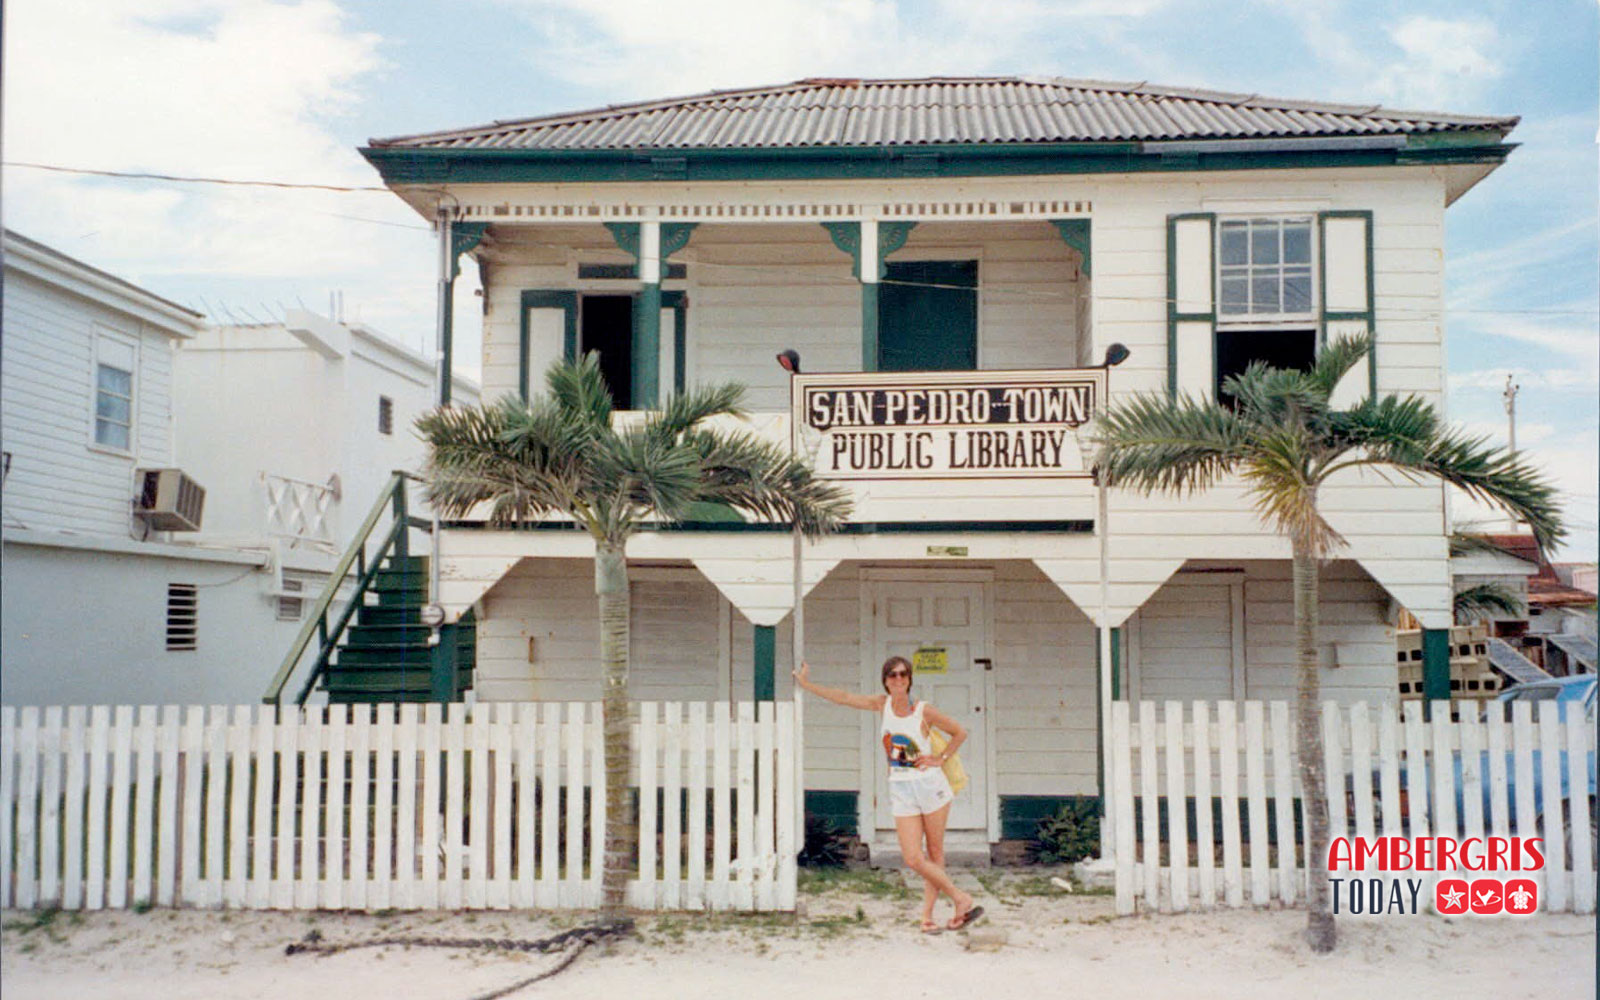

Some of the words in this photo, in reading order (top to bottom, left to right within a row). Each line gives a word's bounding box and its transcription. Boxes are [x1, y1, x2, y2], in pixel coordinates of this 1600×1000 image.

[811, 391, 876, 426] SAN
[885, 389, 992, 425] PEDRO
[1003, 387, 1087, 424] TOWN
[831, 432, 934, 470] PUBLIC
[949, 429, 1067, 468] LIBRARY
